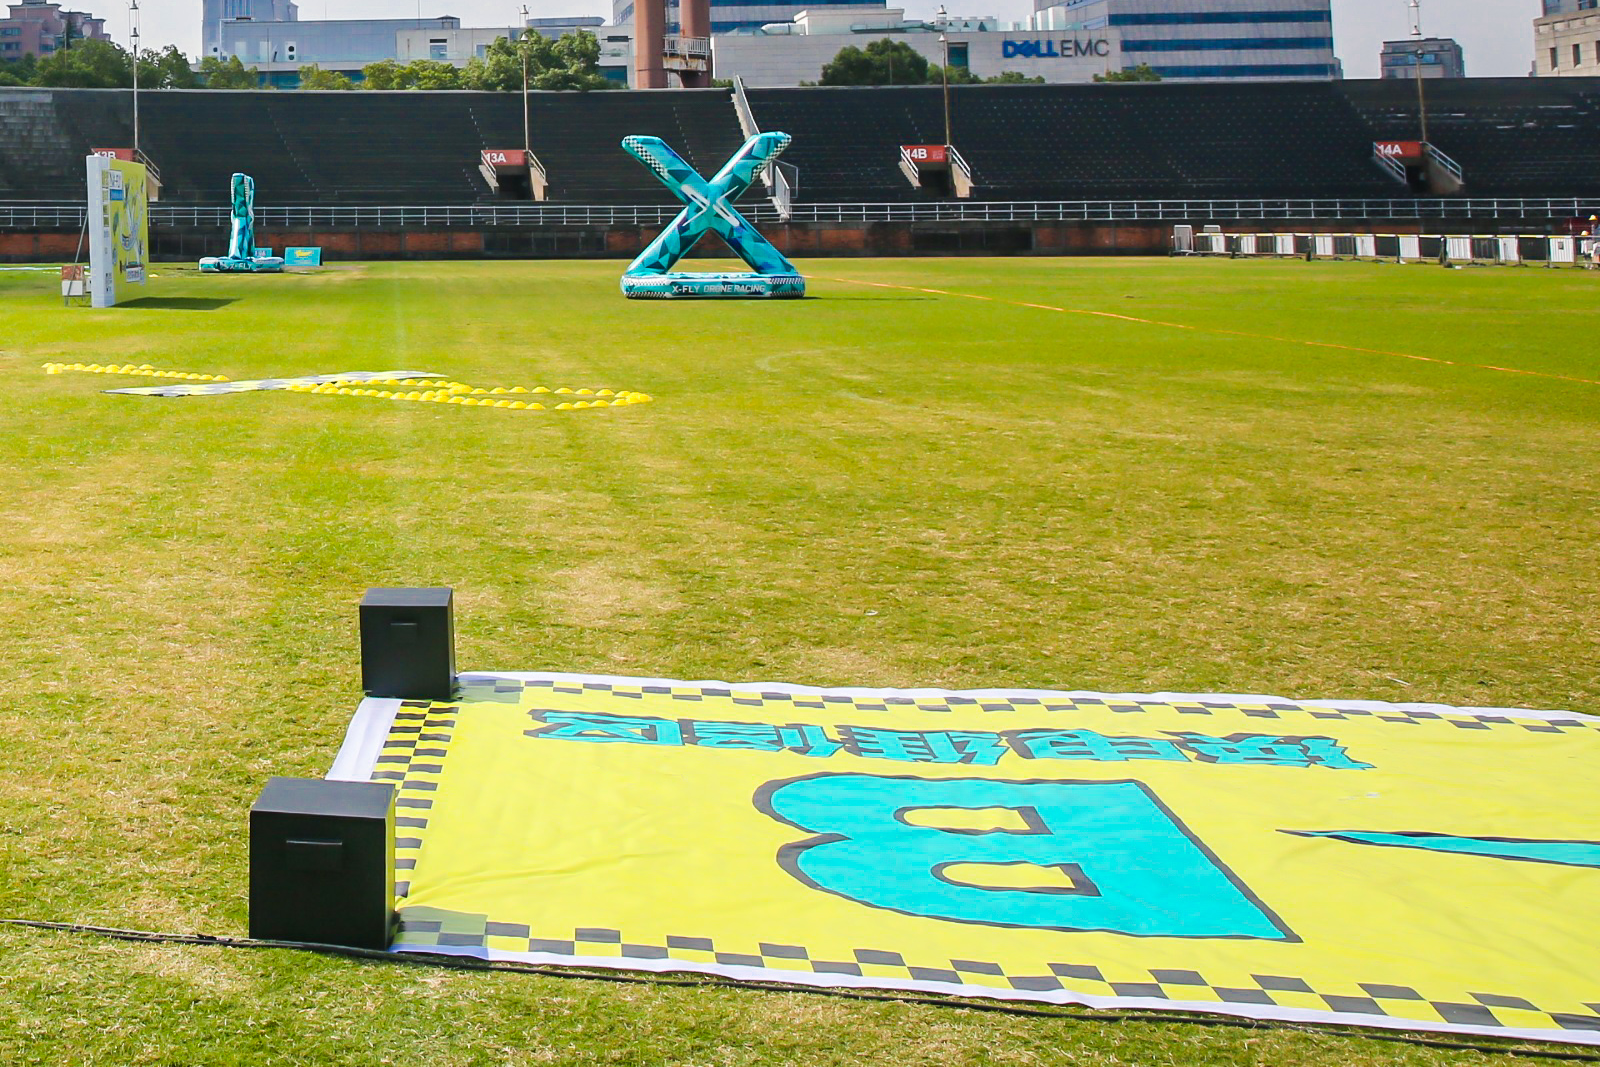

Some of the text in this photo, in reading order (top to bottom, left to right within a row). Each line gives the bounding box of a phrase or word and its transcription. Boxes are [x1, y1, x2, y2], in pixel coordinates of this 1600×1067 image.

[1379, 144, 1403, 155] 14A
[672, 284, 766, 294] X-FLY DRONE RACING
[524, 709, 1378, 770] 换电维修区
[752, 771, 1303, 943] B
